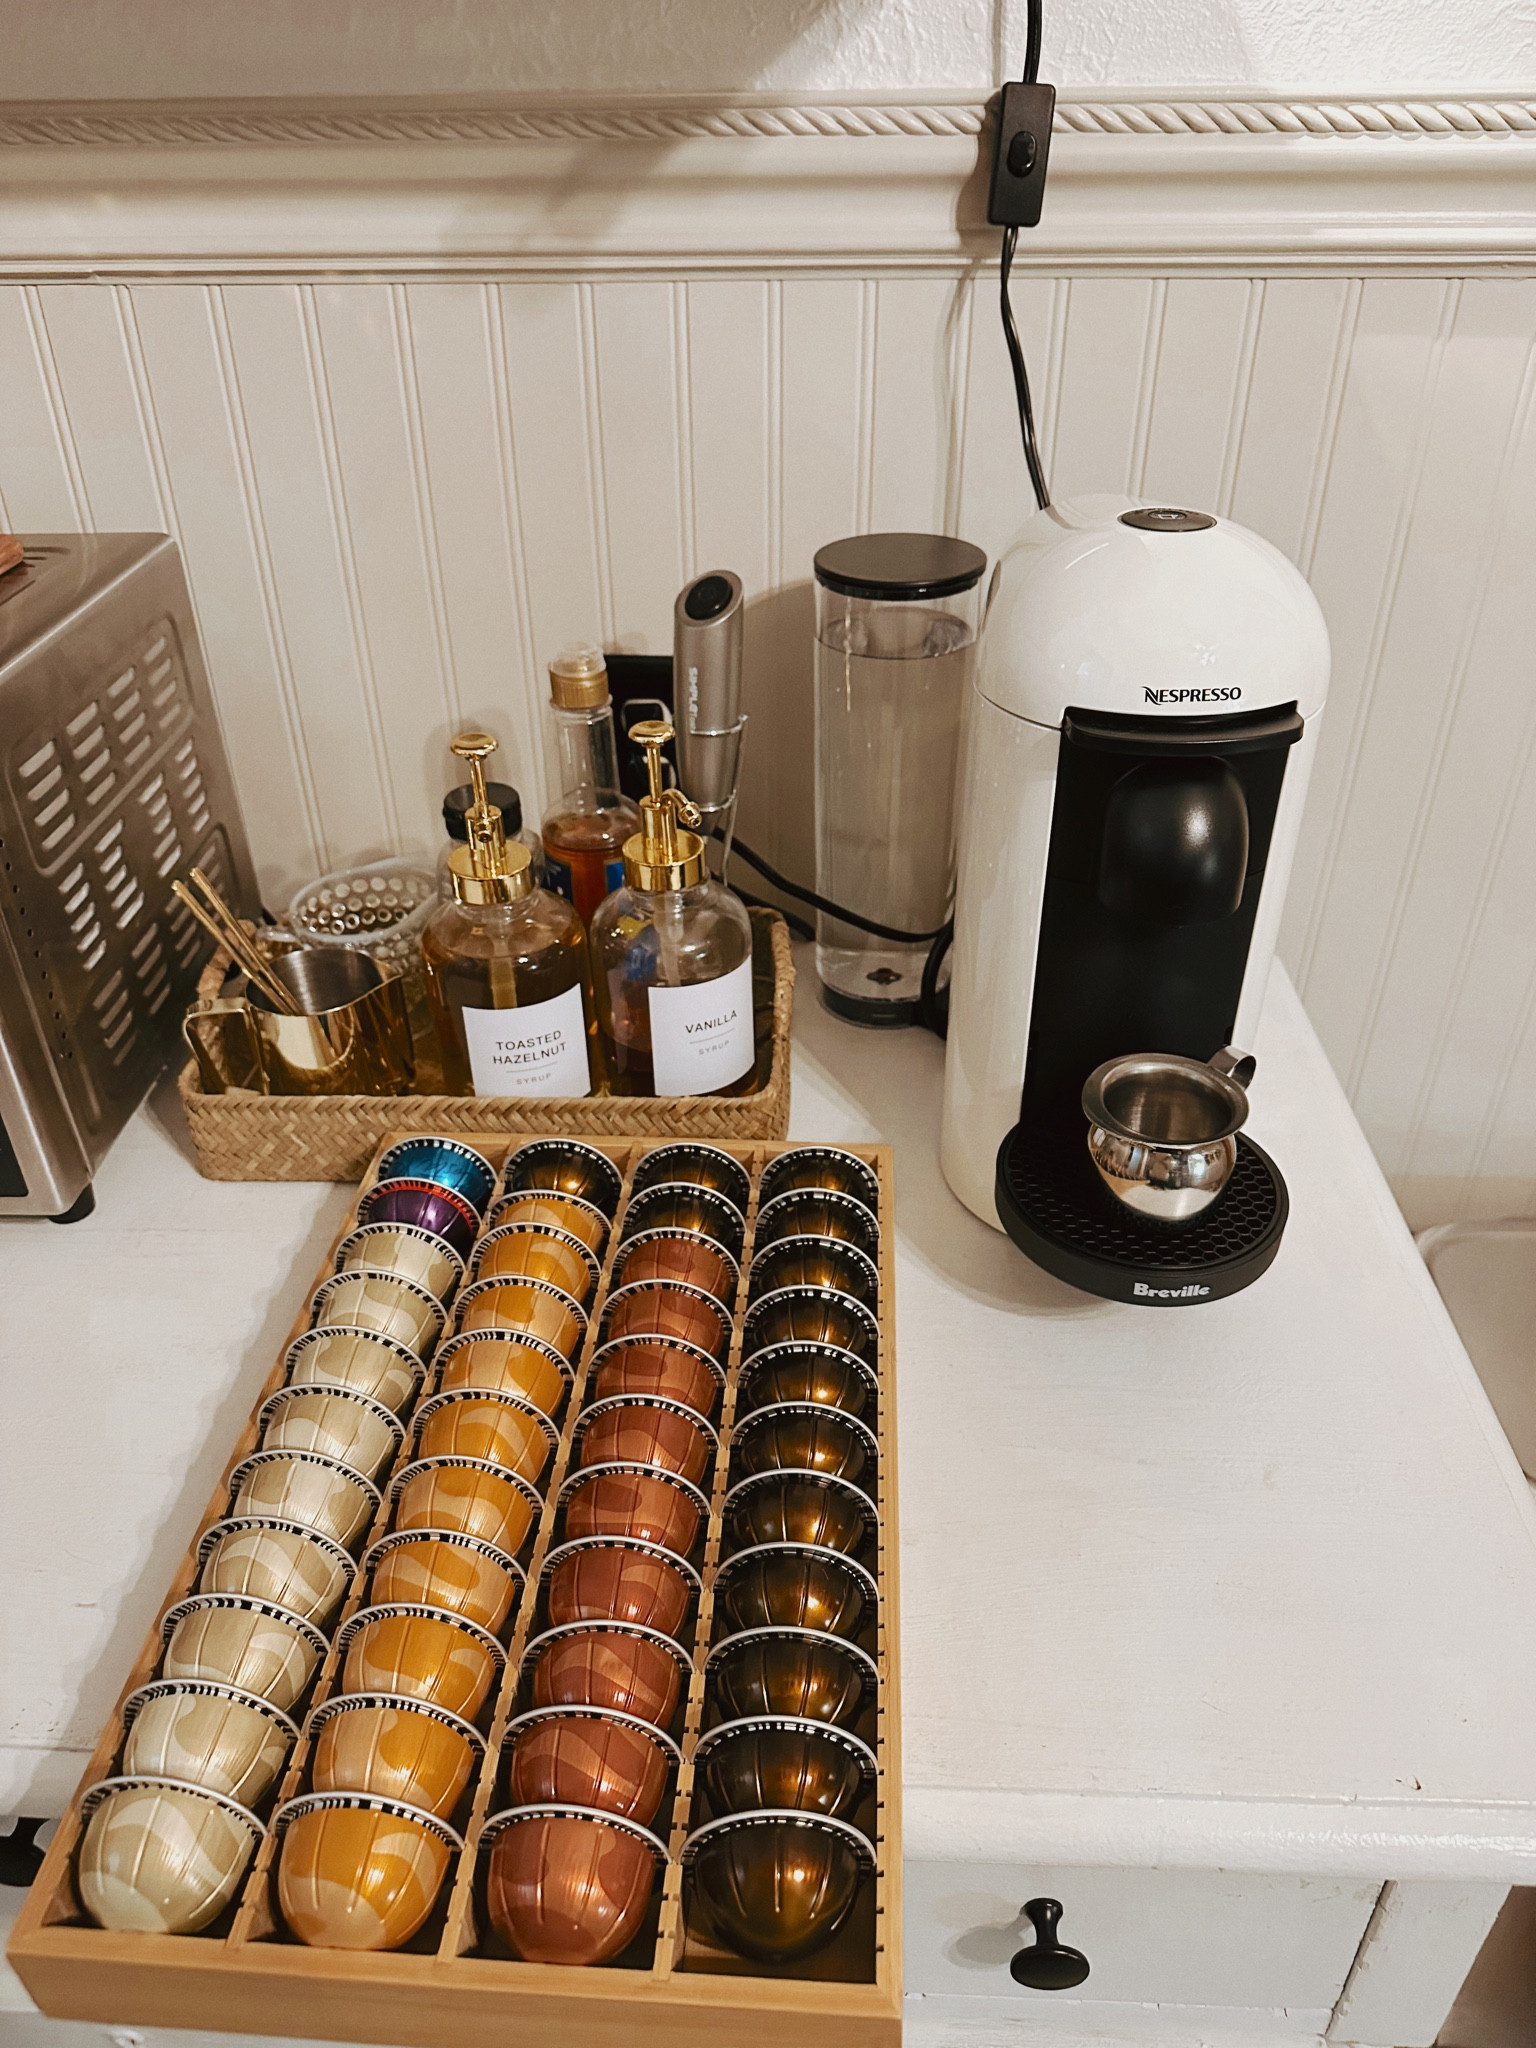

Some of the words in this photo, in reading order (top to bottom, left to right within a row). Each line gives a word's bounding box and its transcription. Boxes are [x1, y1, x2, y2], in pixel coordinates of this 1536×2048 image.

[1141, 686, 1242, 705] NESPRESSO
[685, 1009, 738, 1034] VANILLA
[496, 1030, 562, 1051] TOASTED
[698, 1039, 730, 1055] SYRUP
[492, 1041, 567, 1064] HAZELNUT
[515, 1072, 552, 1085] SYRUP
[1133, 1282, 1211, 1299] Breville
